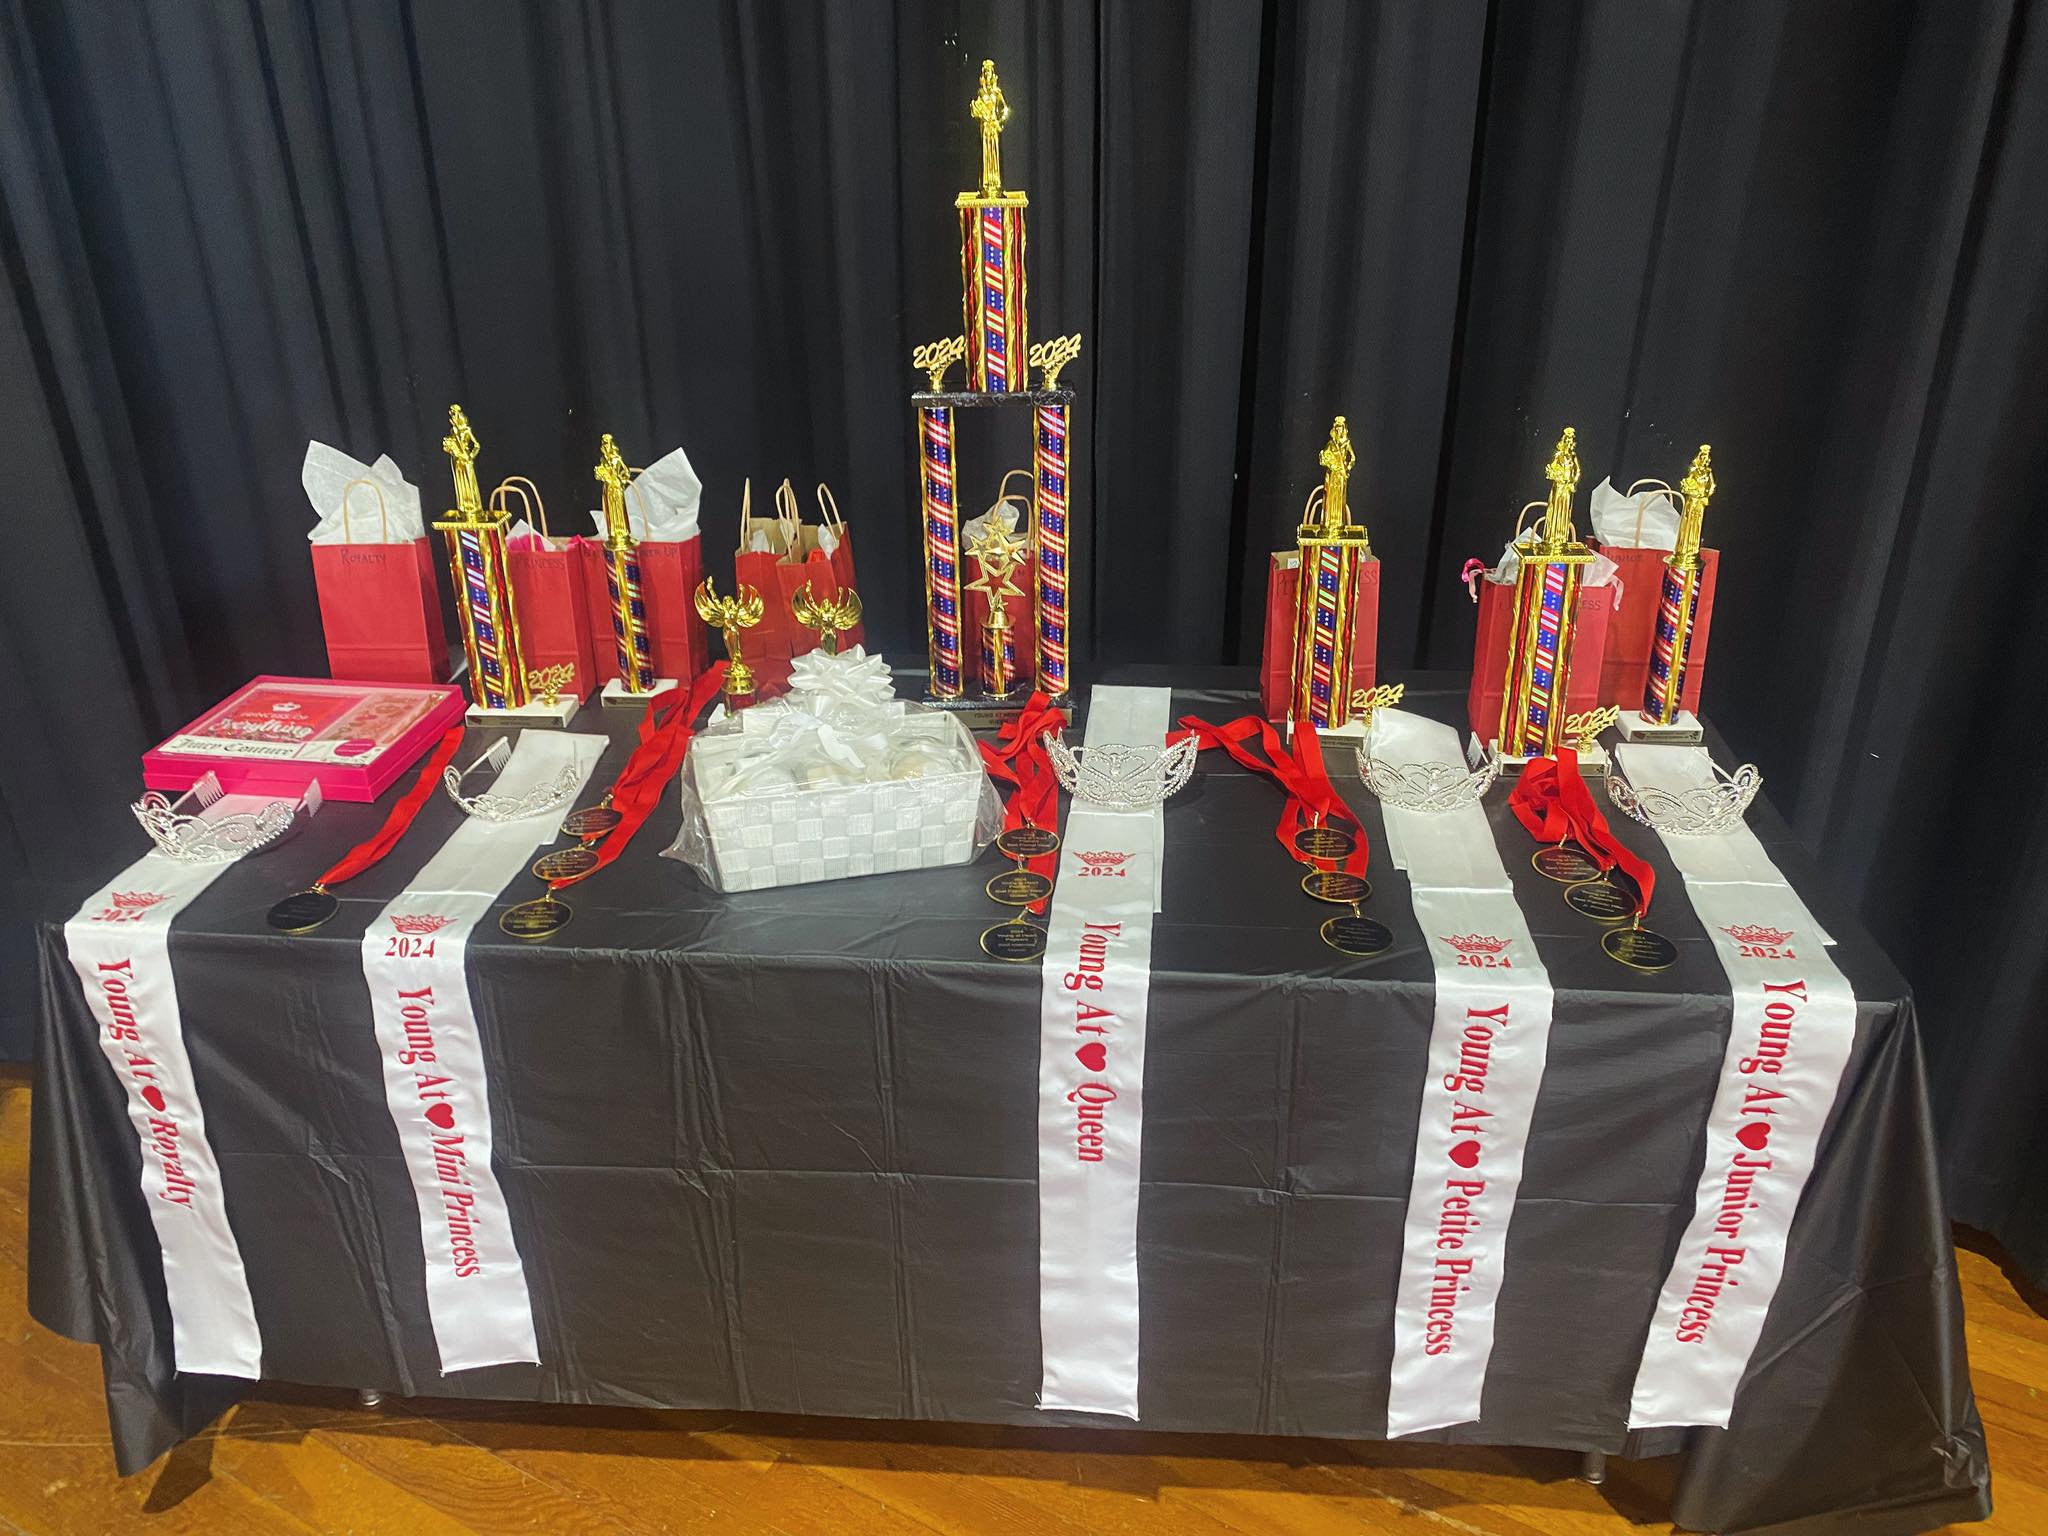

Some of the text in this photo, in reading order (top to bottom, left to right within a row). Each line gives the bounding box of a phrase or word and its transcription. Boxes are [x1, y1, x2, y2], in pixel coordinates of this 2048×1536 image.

[913, 334, 966, 369] 2024
[1029, 333, 1081, 369] 2024
[528, 662, 575, 689] 2024
[1352, 683, 1405, 709] 2024
[1565, 704, 1620, 734] 2024
[1078, 866, 1126, 878] 2024
[384, 936, 437, 959] 2024
[1456, 954, 1513, 969] 2024
[1739, 945, 1798, 961] 2024
[1064, 922, 1122, 1163] Young At Queen
[97, 958, 142, 1042] Young
[148, 1116, 197, 1210] Royalty
[397, 986, 481, 1279] Young At Mini Princess
[1675, 979, 1808, 1344] Young At Junior Princess
[1424, 1003, 1510, 1356] Young At Petite Princess
